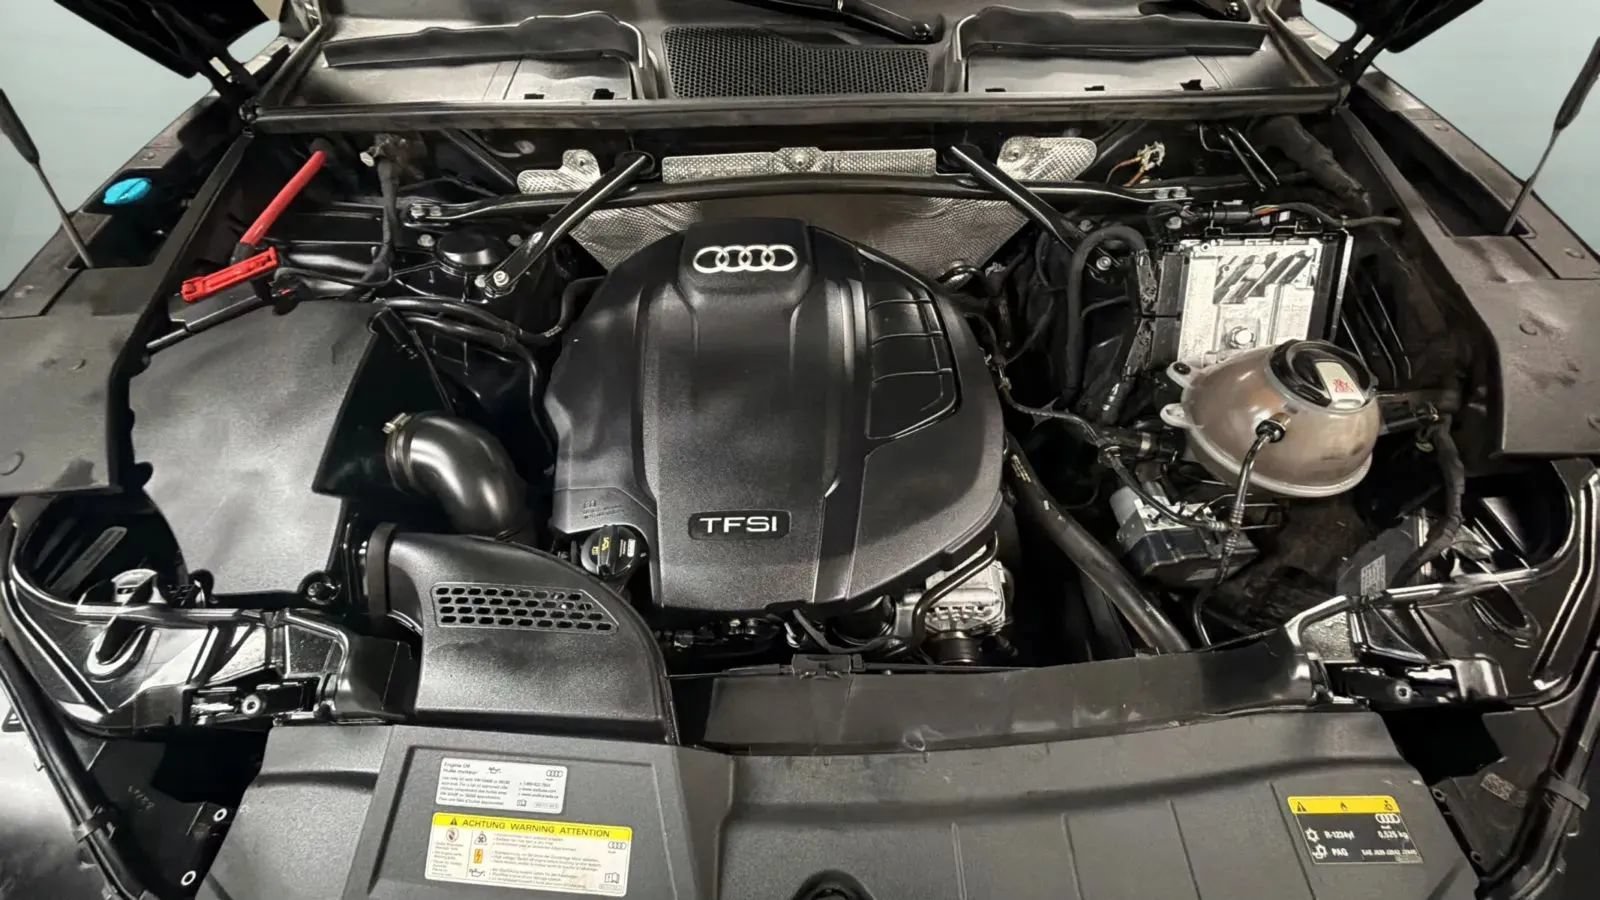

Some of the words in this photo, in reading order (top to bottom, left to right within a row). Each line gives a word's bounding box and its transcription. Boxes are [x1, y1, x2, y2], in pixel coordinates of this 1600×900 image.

[699, 516, 777, 533] TFSI
[462, 819, 506, 830] ACHTUNG
[510, 823, 555, 834] WARNING
[559, 826, 610, 838] ATTENTION
[1331, 848, 1349, 857] PAG
